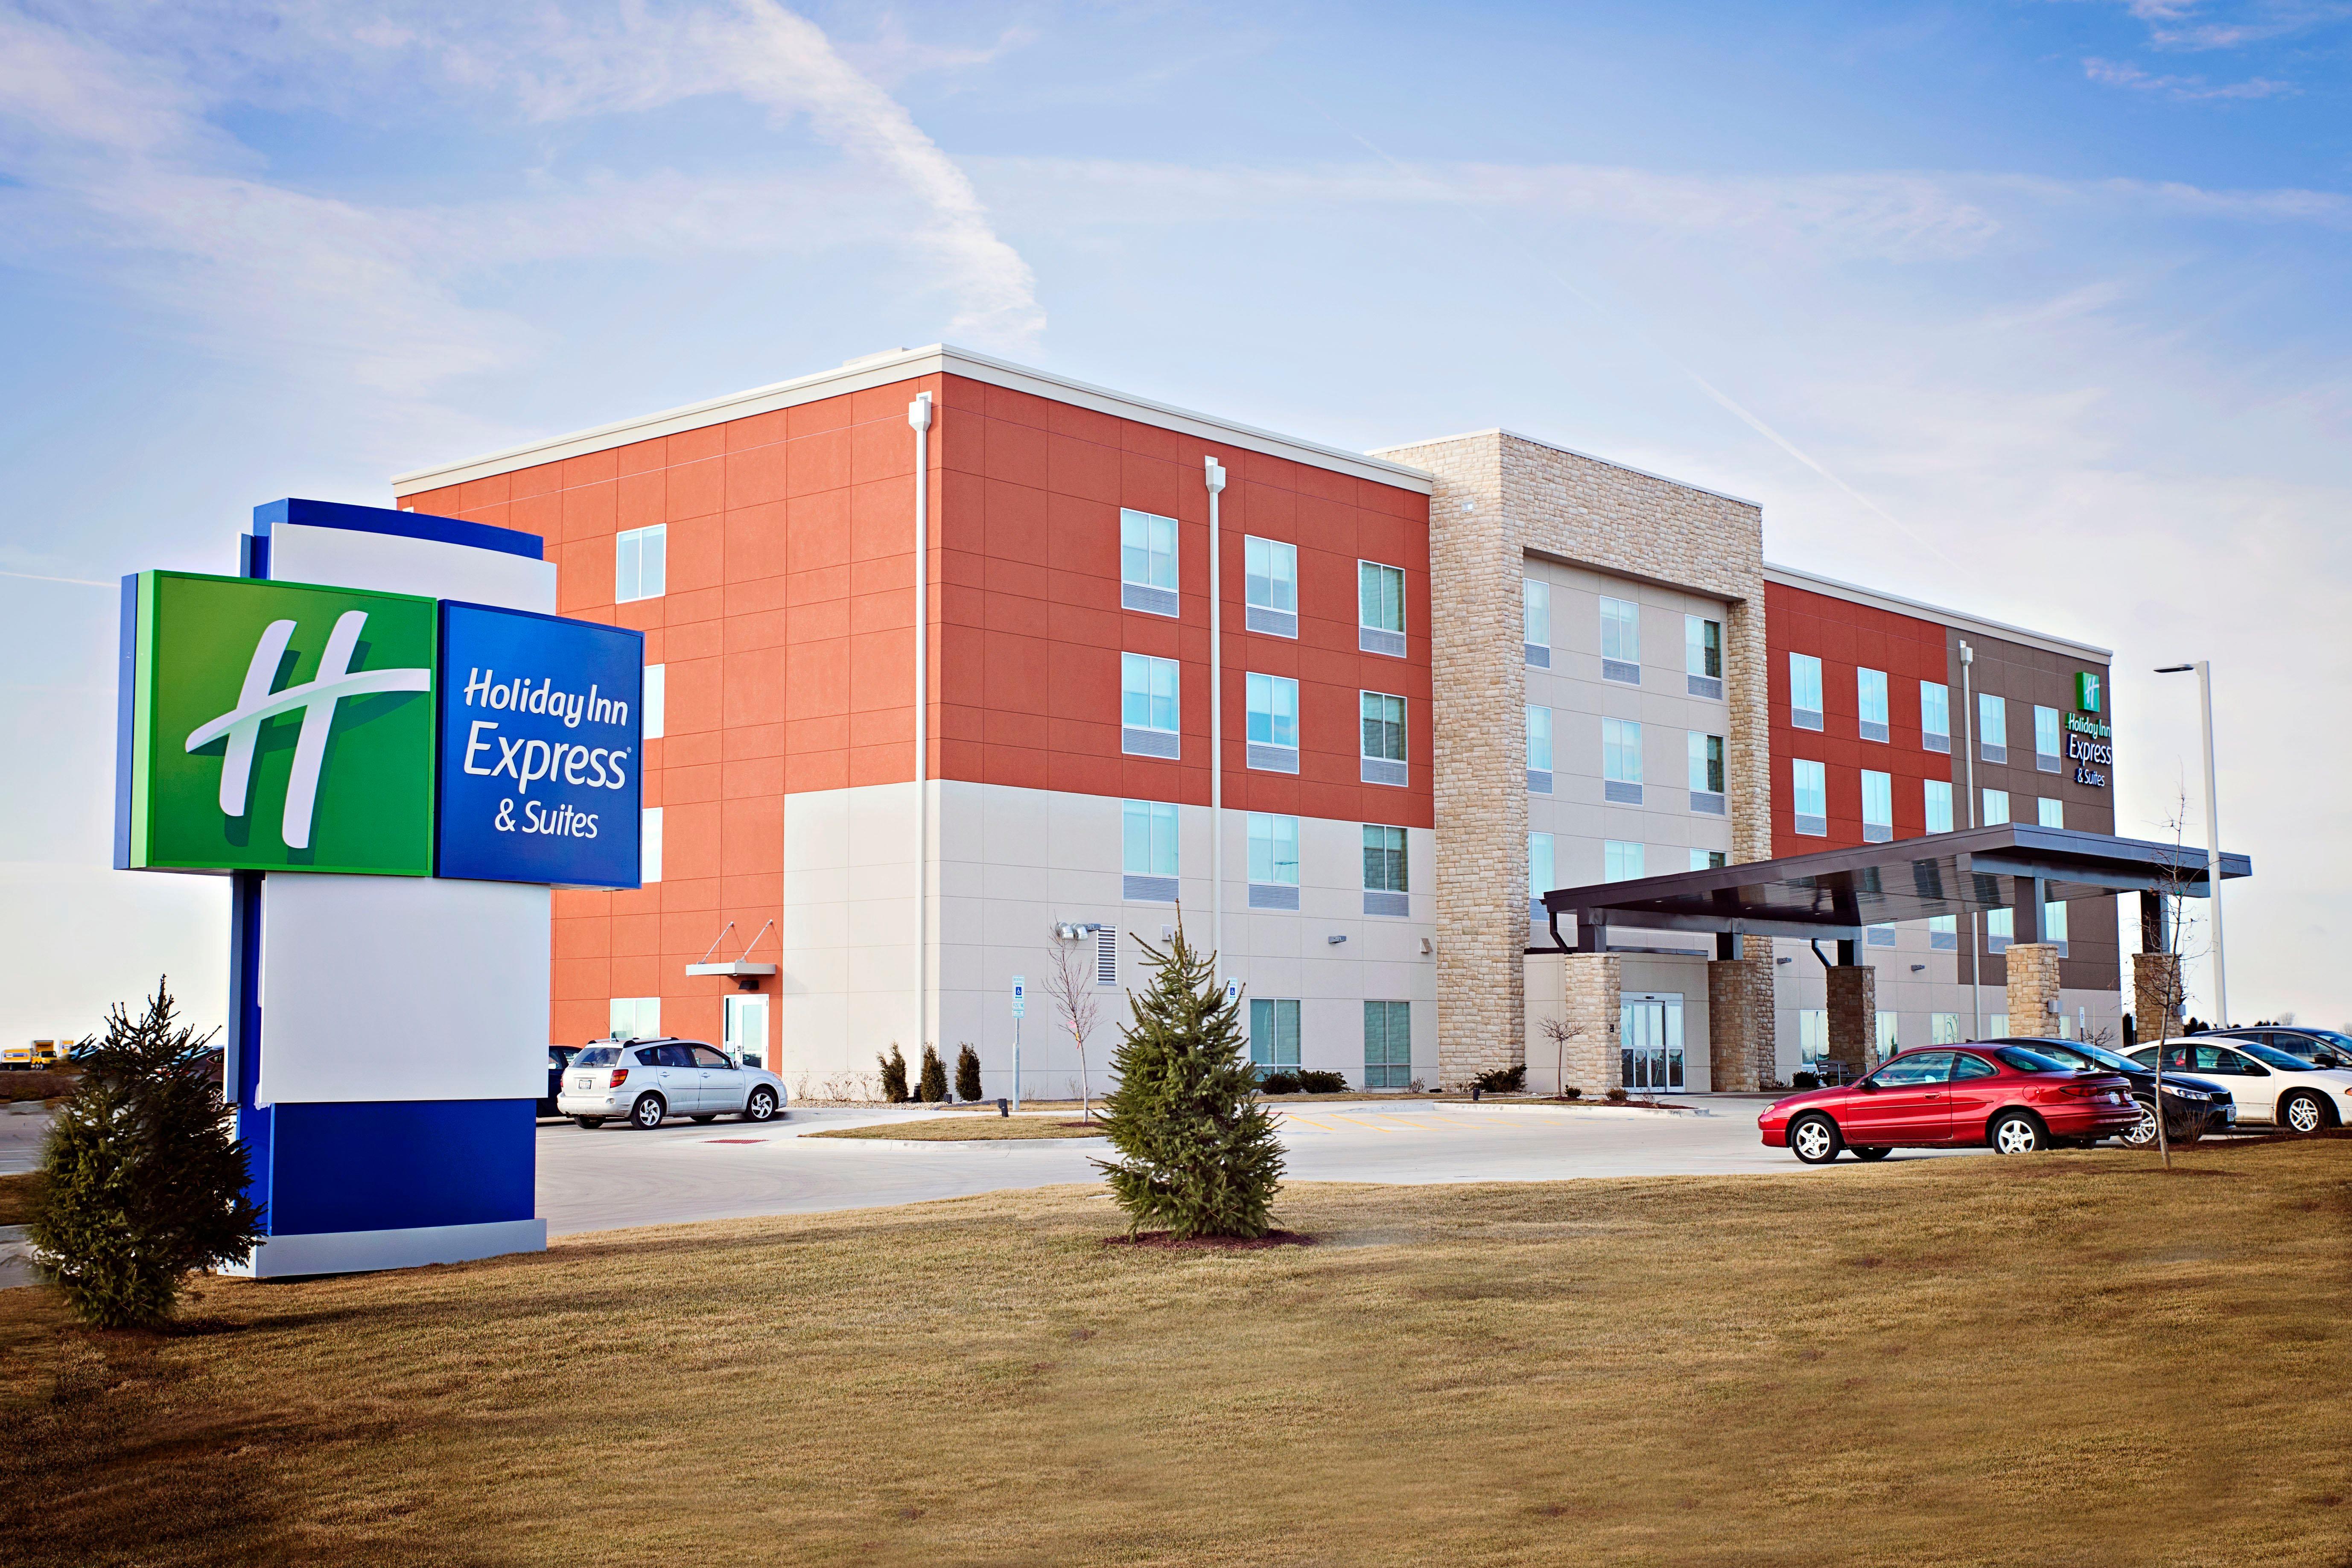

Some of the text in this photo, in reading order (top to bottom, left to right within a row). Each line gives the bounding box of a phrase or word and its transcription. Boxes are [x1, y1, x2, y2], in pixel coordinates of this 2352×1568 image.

[464, 667, 628, 728] Holiday Inn
[2068, 712, 2110, 739] Holiday Inn
[2070, 733, 2111, 766] Express
[2078, 768, 2105, 787] & Suites
[495, 798, 598, 838] & Suites
